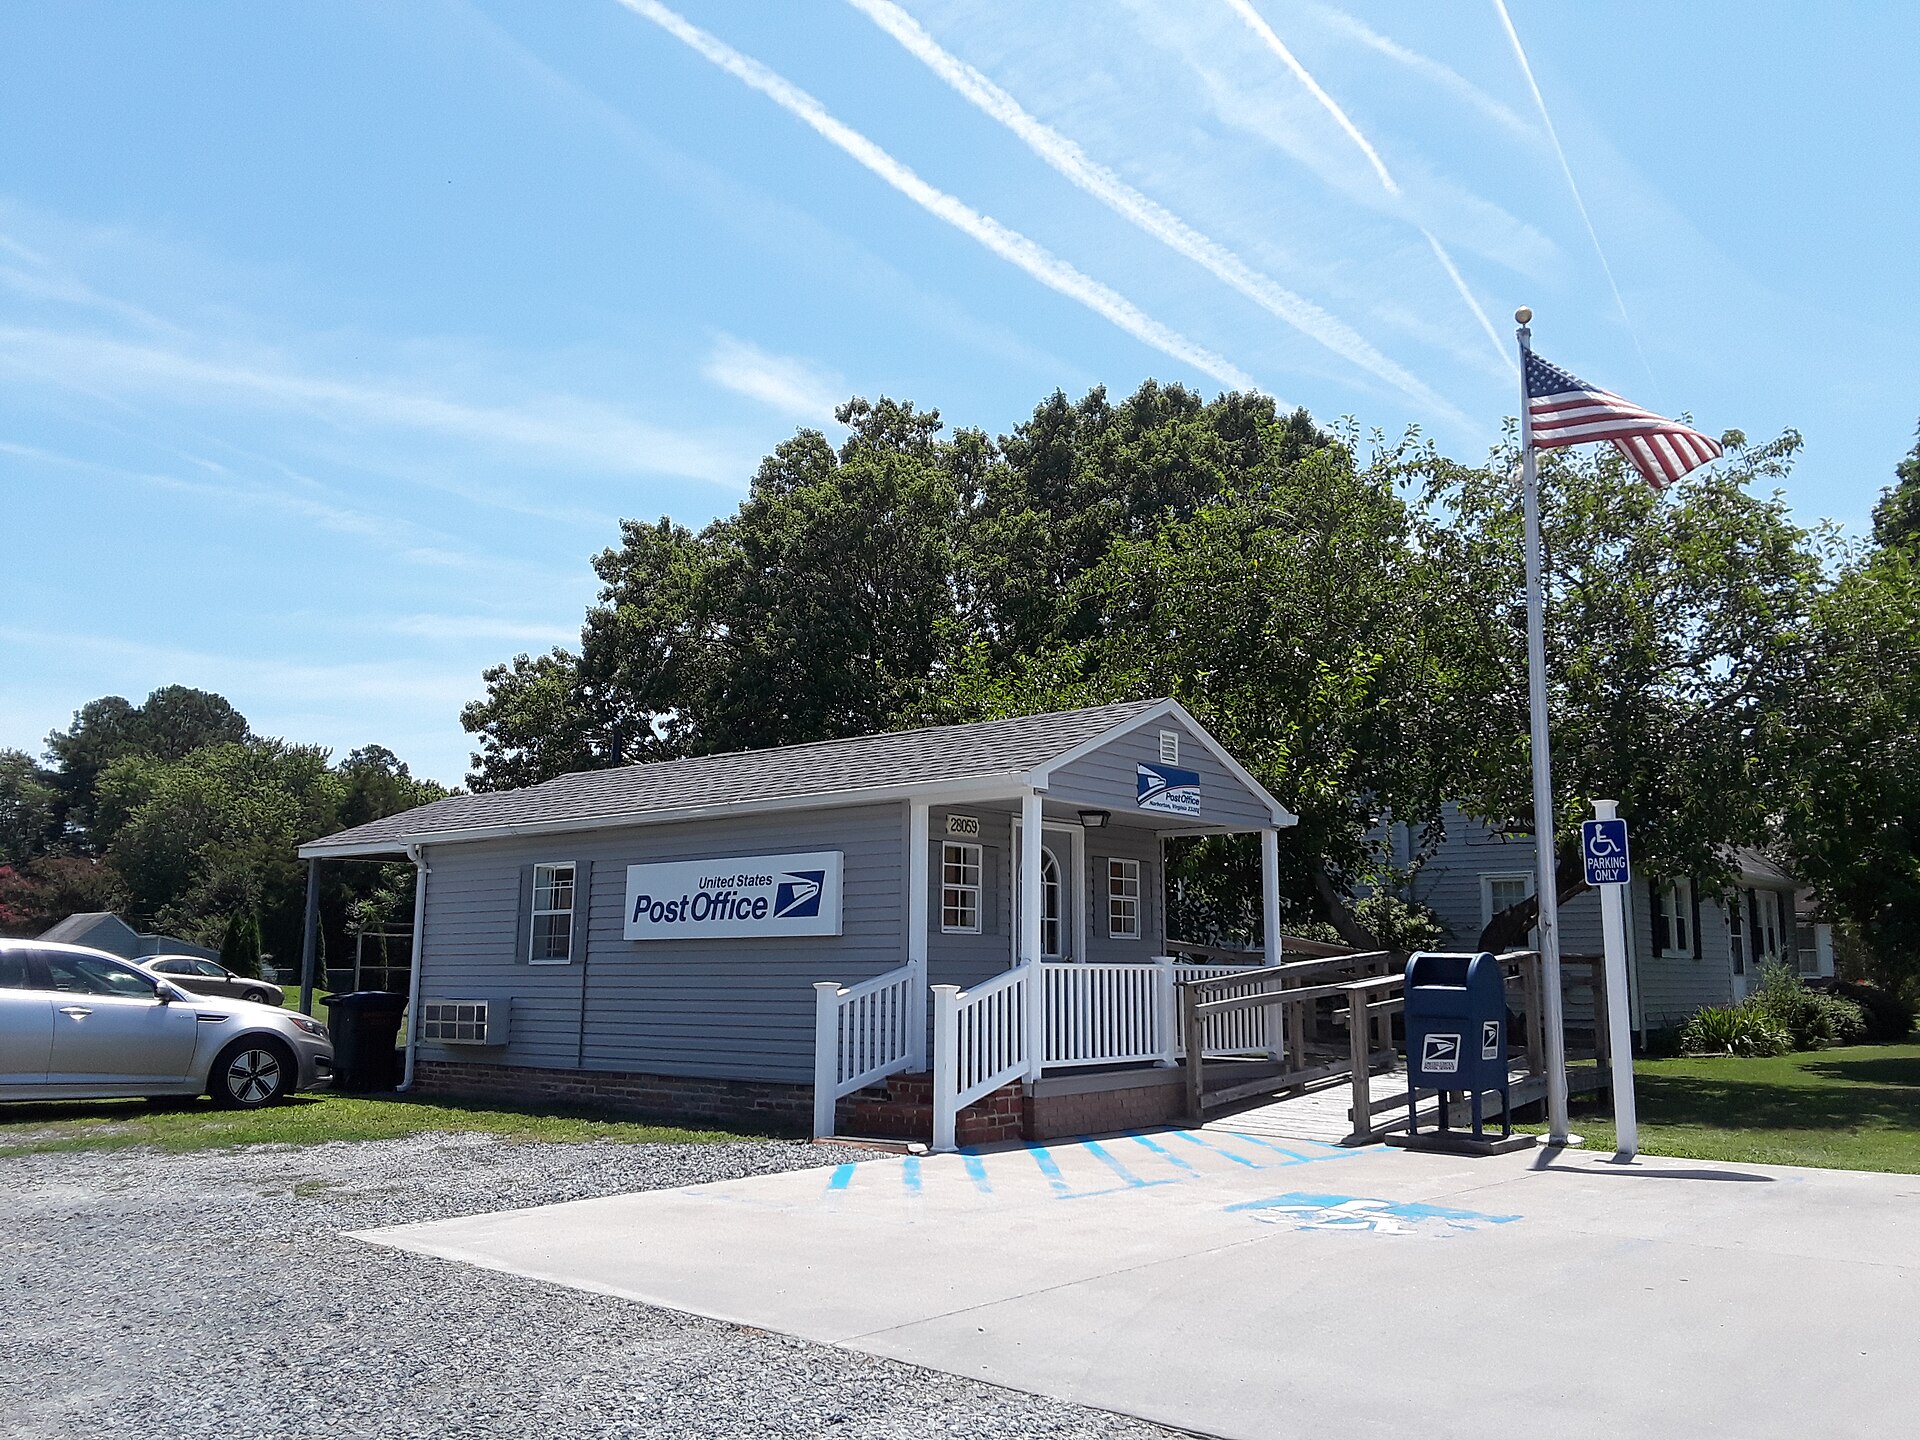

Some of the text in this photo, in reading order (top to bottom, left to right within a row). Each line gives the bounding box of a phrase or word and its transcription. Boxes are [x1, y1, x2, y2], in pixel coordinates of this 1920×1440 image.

[1166, 791, 1181, 803] Post
[951, 817, 978, 833] 28059
[1587, 856, 1626, 870] PARKING
[699, 873, 773, 889] United States
[1595, 868, 1619, 881] ONLY
[632, 891, 769, 923] Post Office
